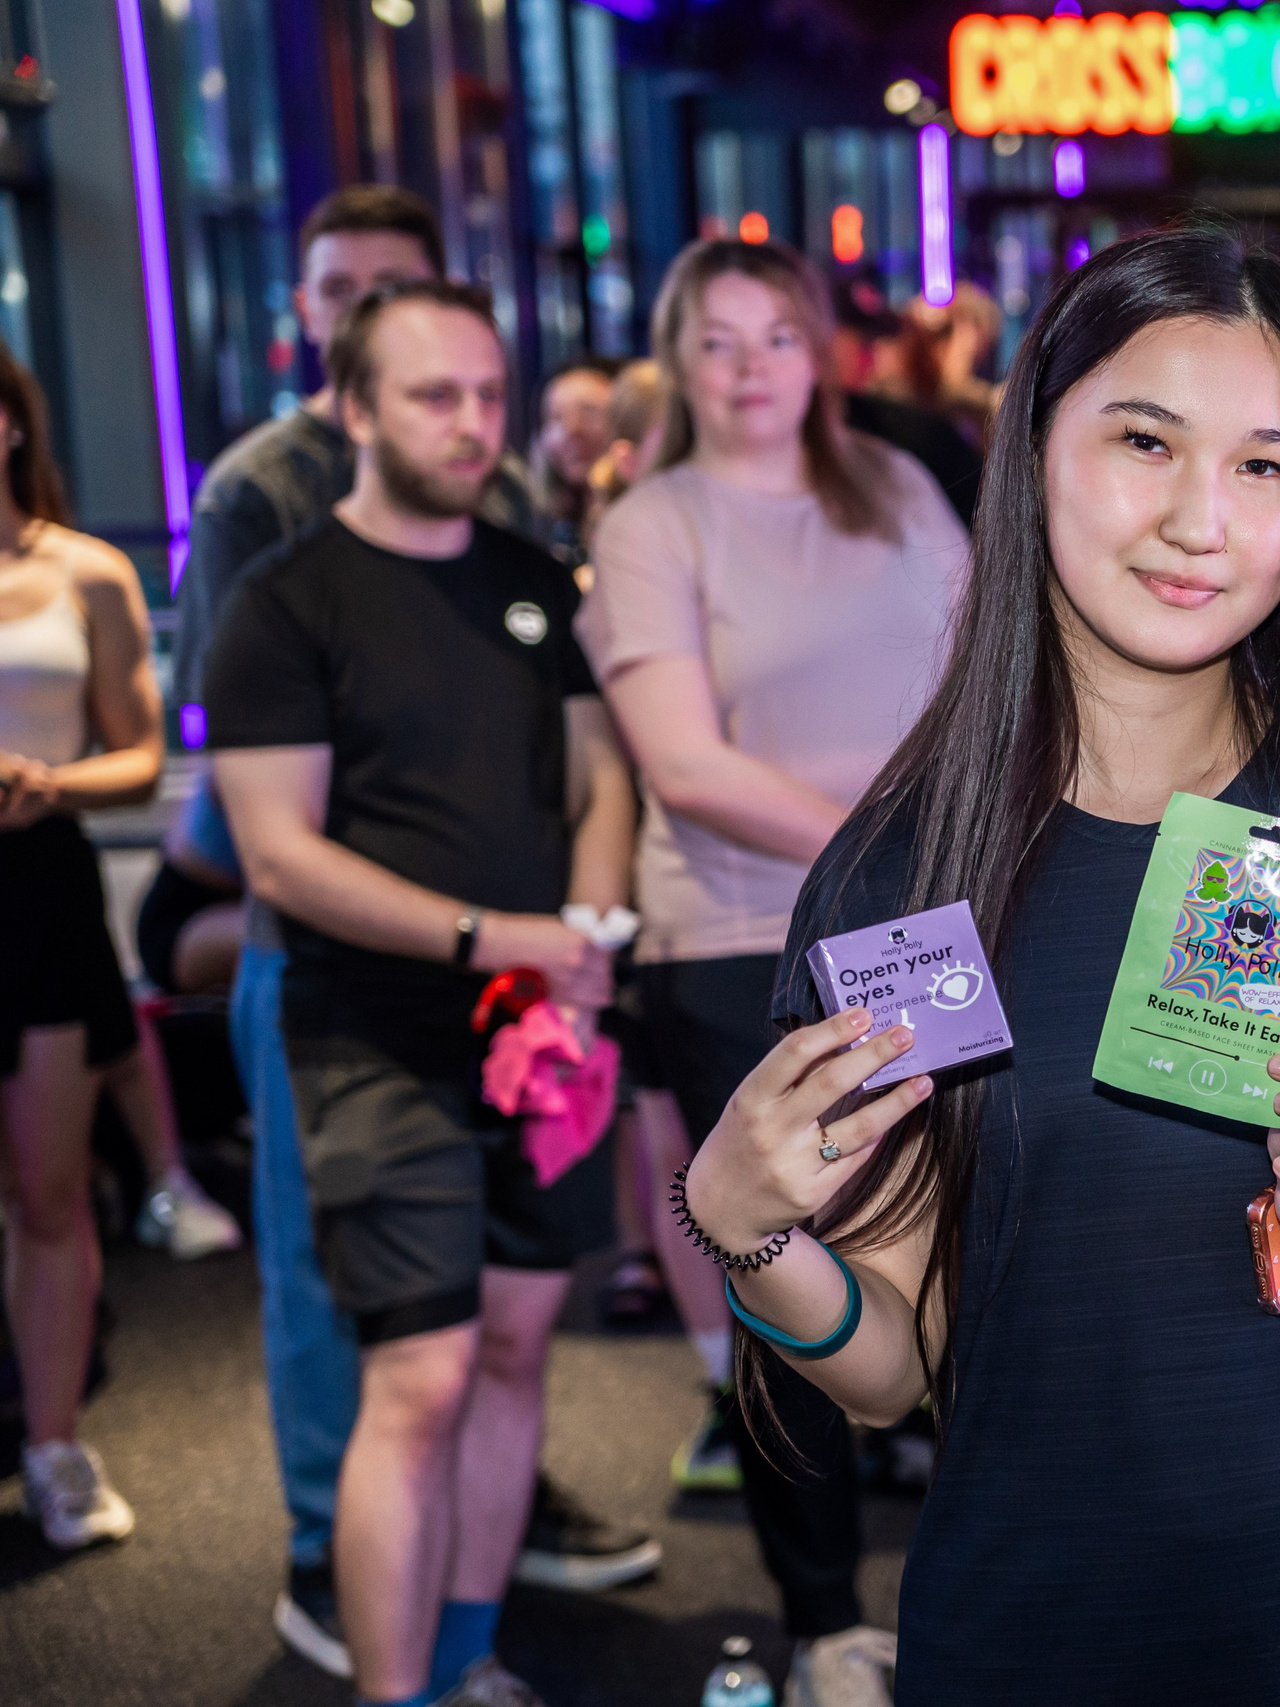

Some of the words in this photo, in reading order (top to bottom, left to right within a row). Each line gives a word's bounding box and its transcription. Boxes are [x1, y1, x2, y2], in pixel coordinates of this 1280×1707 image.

[1209, 840, 1247, 855] CANNABIS
[881, 947, 901, 958] Holly
[904, 940, 922, 951] Polly
[1185, 937, 1240, 970] Holly
[839, 962, 899, 987] Open
[904, 946, 953, 974] your
[846, 984, 895, 1008] eyes
[872, 990, 943, 1019] рогелевые
[870, 1019, 892, 1032] тчи
[1147, 993, 1199, 1022] Relax,
[1202, 1008, 1240, 1031] Take
[1244, 1021, 1256, 1036] It
[958, 1036, 1004, 1053] Moisturizing
[1160, 1021, 1210, 1039] CREAM-BASED
[1213, 1035, 1231, 1045] FACE
[1233, 1041, 1255, 1051] SHEET
